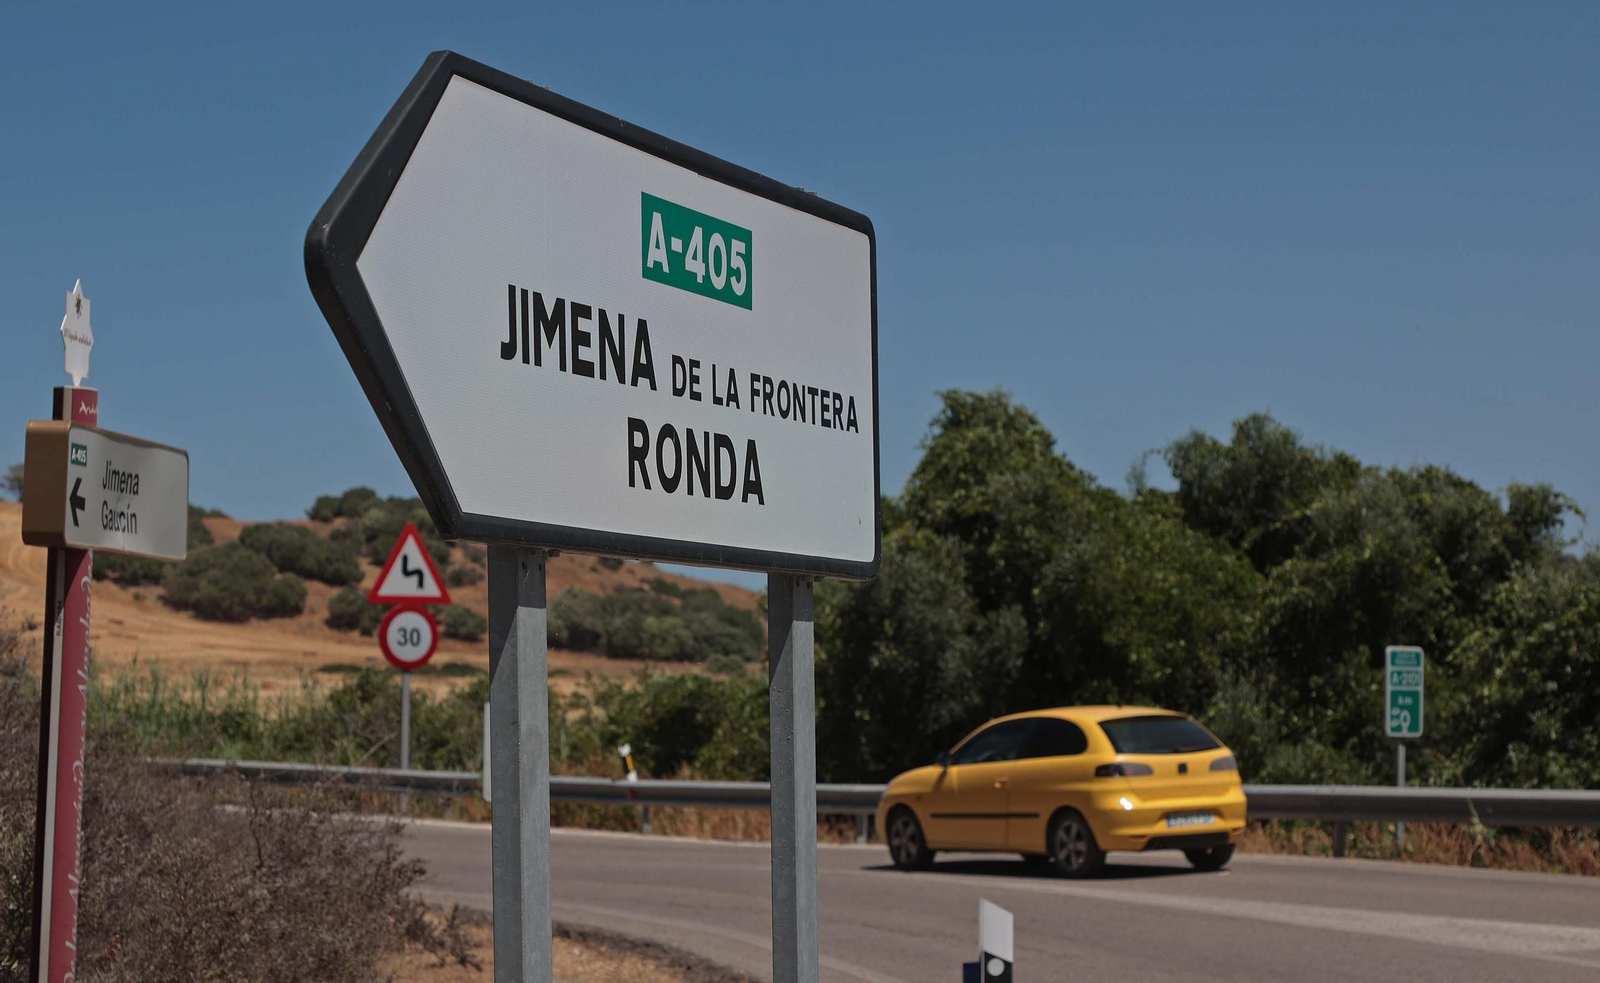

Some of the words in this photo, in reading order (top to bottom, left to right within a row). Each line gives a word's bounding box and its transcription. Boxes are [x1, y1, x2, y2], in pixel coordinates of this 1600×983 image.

[646, 211, 747, 296] A-405
[500, 284, 657, 391] JIMENA
[672, 354, 702, 402] DE
[712, 364, 740, 410] LA
[750, 372, 859, 433] FRONTERA
[71, 447, 86, 463] A-405
[627, 416, 765, 505] RONDA
[102, 460, 139, 496] Jimena
[101, 500, 137, 535] Gaucín
[396, 626, 421, 647] 30
